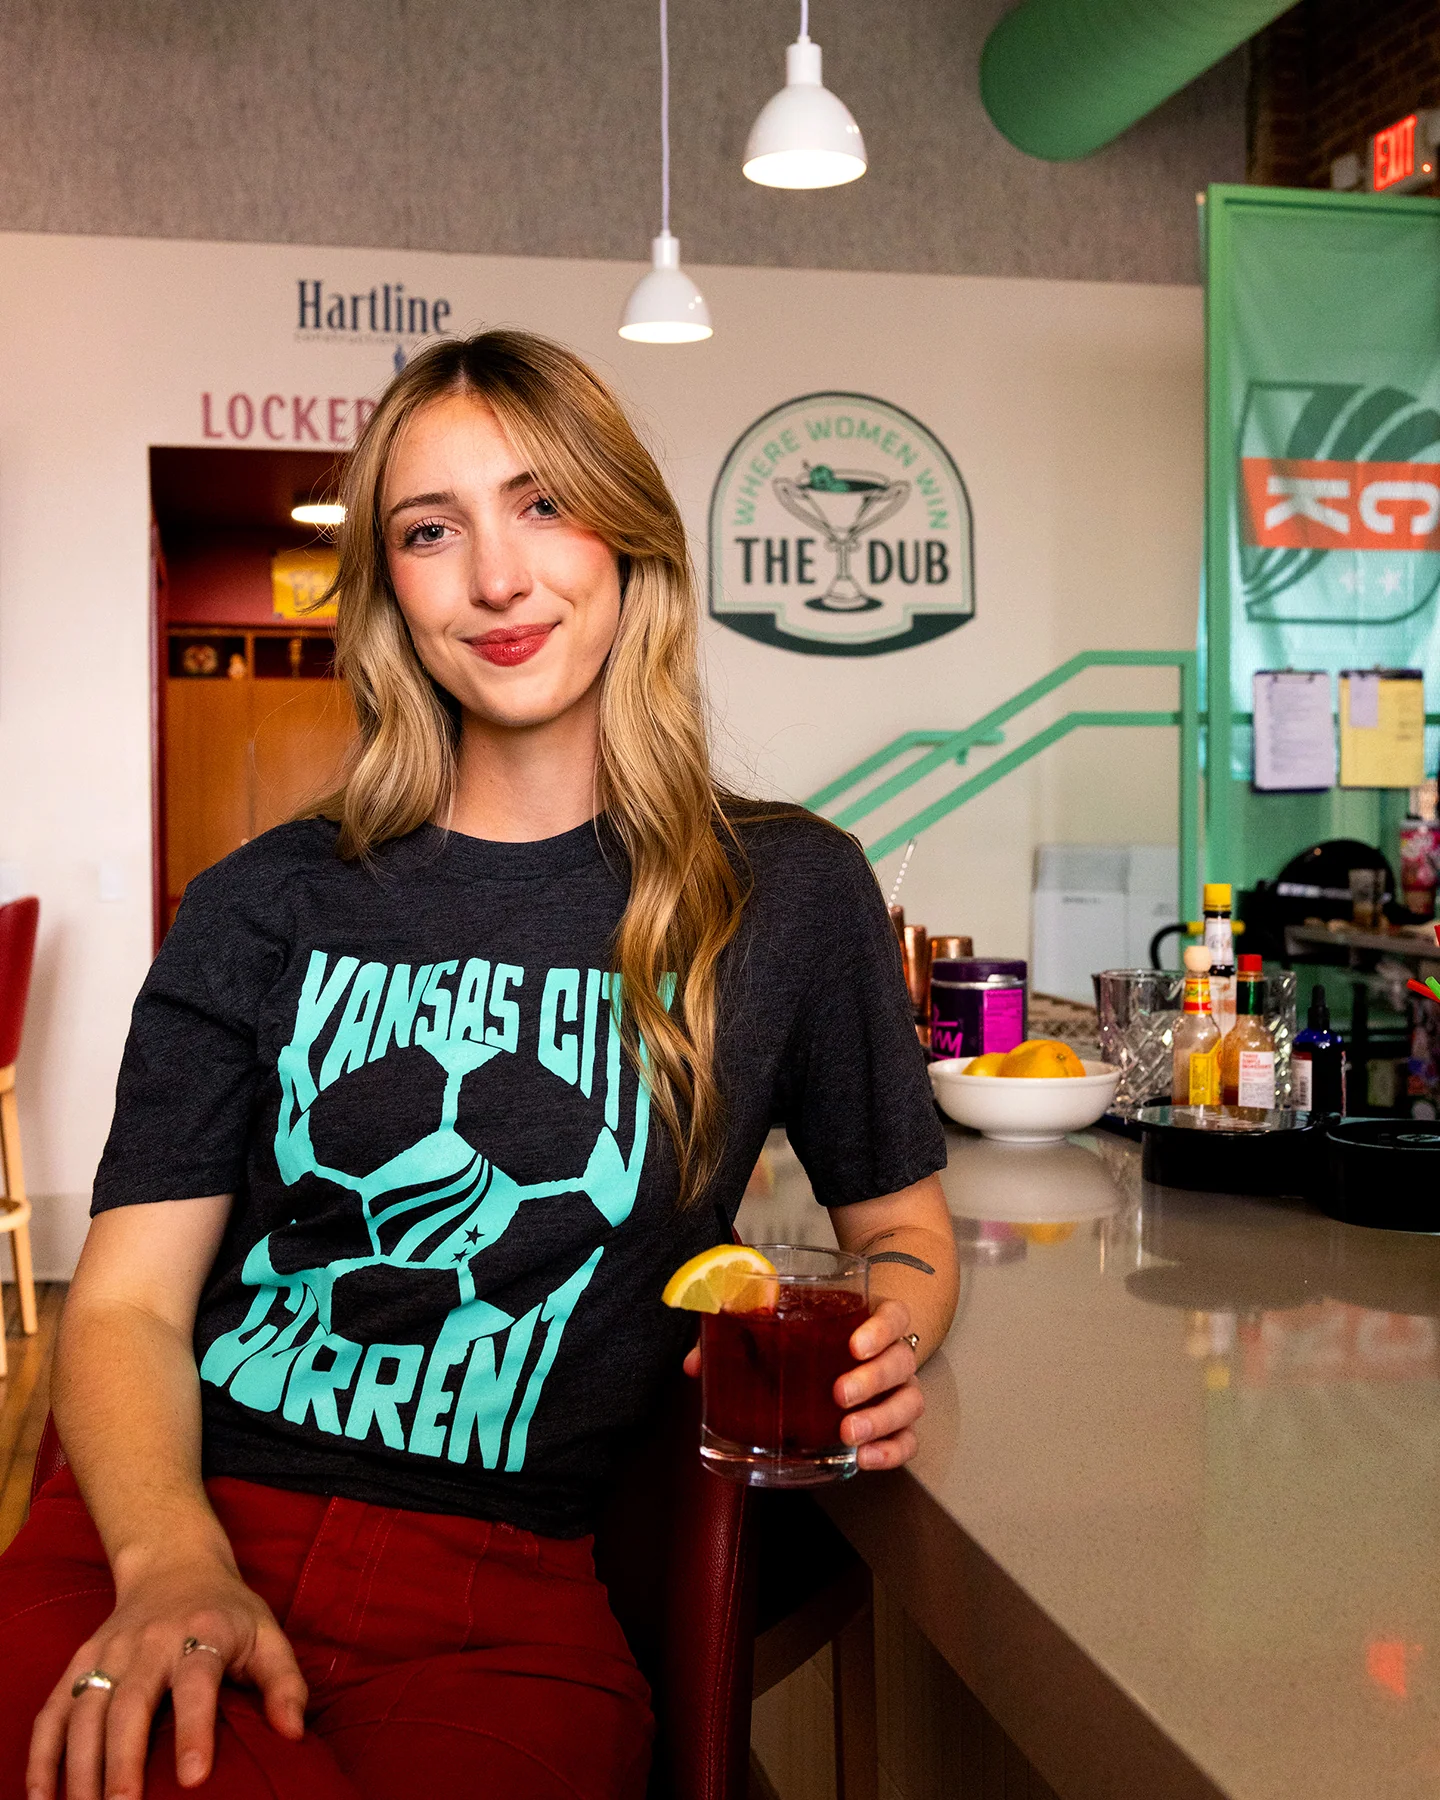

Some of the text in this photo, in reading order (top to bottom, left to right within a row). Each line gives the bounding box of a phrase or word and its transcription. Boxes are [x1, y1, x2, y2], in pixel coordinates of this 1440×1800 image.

[1374, 114, 1418, 191] EXIT
[298, 280, 452, 334] Hartline
[732, 416, 950, 530] WHERE WOMEN WIN
[735, 537, 950, 586] THE DUB
[276, 949, 677, 1227] KANSAS CITY
[200, 1232, 604, 1473] CURRENT
